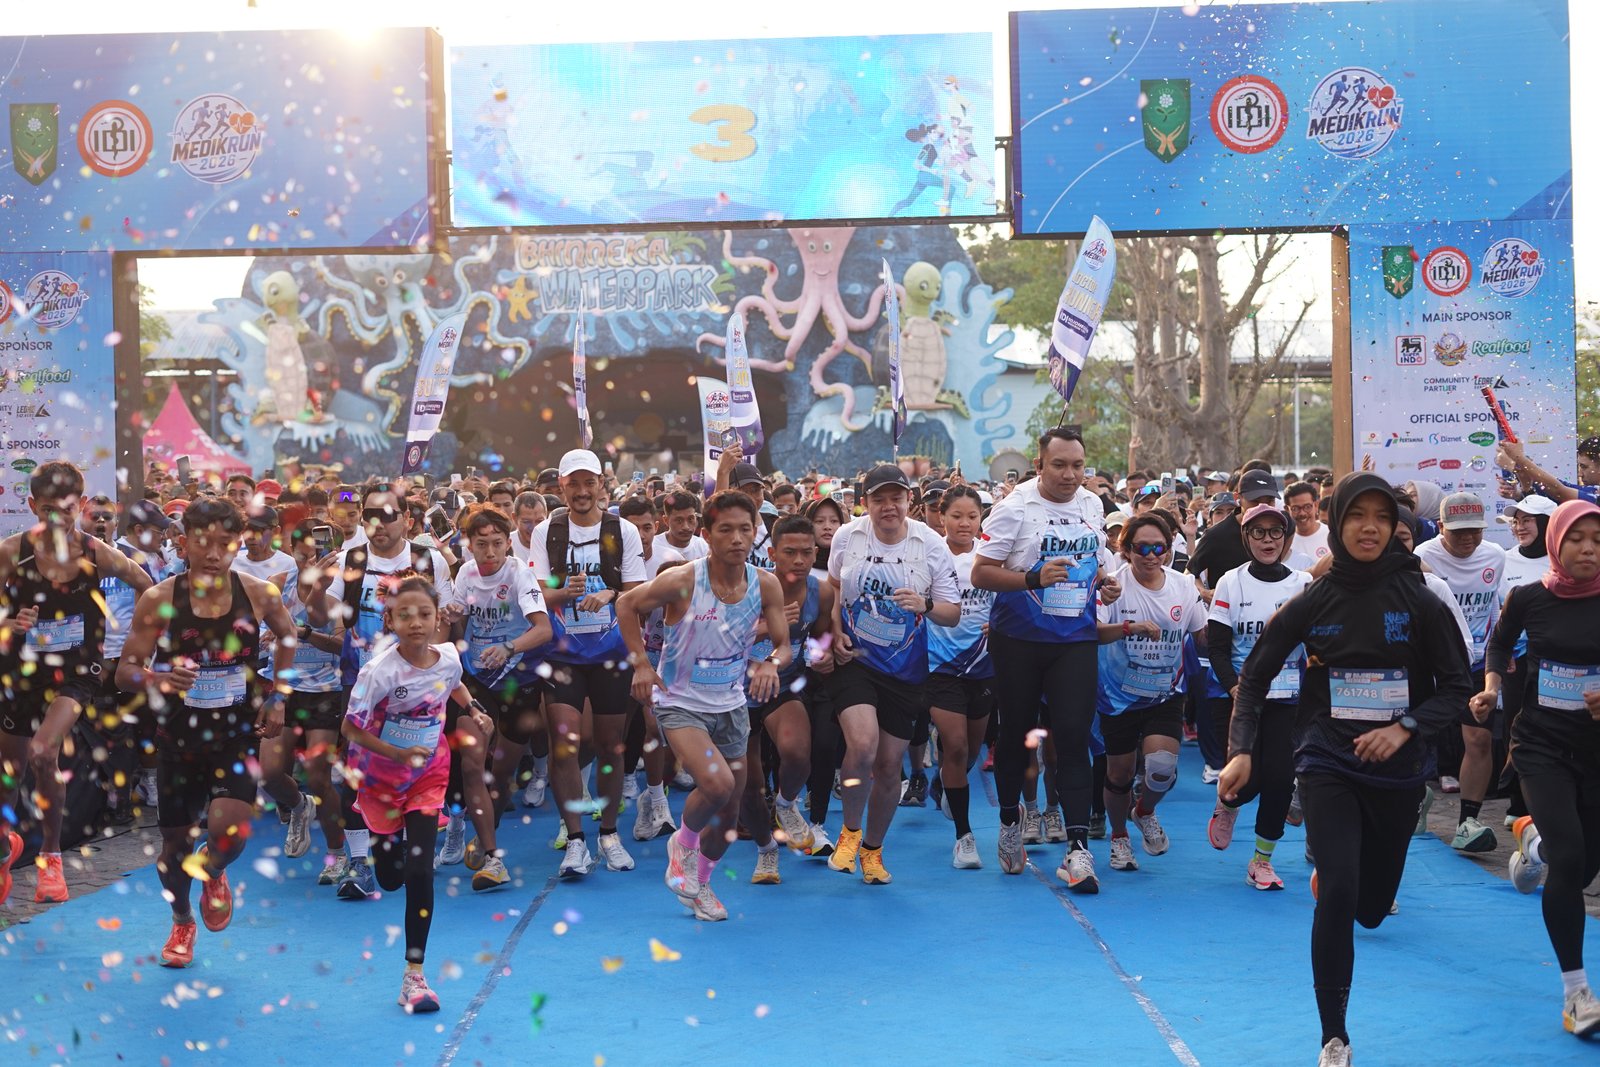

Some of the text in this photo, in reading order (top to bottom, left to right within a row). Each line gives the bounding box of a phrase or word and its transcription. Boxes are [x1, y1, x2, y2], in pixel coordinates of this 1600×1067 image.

[1309, 107, 1401, 137] MEDIKRUN
[688, 104, 757, 161] 3
[1337, 130, 1375, 146] 2026
[172, 134, 262, 162] MEDIKRUN
[200, 154, 236, 170] 2026
[1482, 264, 1544, 285] MEDIKRUN
[539, 267, 721, 312] WATERPARK
[1422, 311, 1512, 323] MAIN SPONSOR
[0, 341, 53, 351] SPONSOR
[1471, 339, 1531, 357] Realfood
[1400, 356, 1423, 364] INDO
[1423, 377, 1470, 385] COMMUNITY
[1410, 411, 1520, 424] OFFICIAL SPONOR
[7, 440, 61, 450] SPONSOR
[192, 683, 222, 692] 61852
[1543, 678, 1582, 692] 761397
[1336, 687, 1378, 699] 761748
[1394, 708, 1406, 717] 5K
[388, 728, 420, 741] 761011
